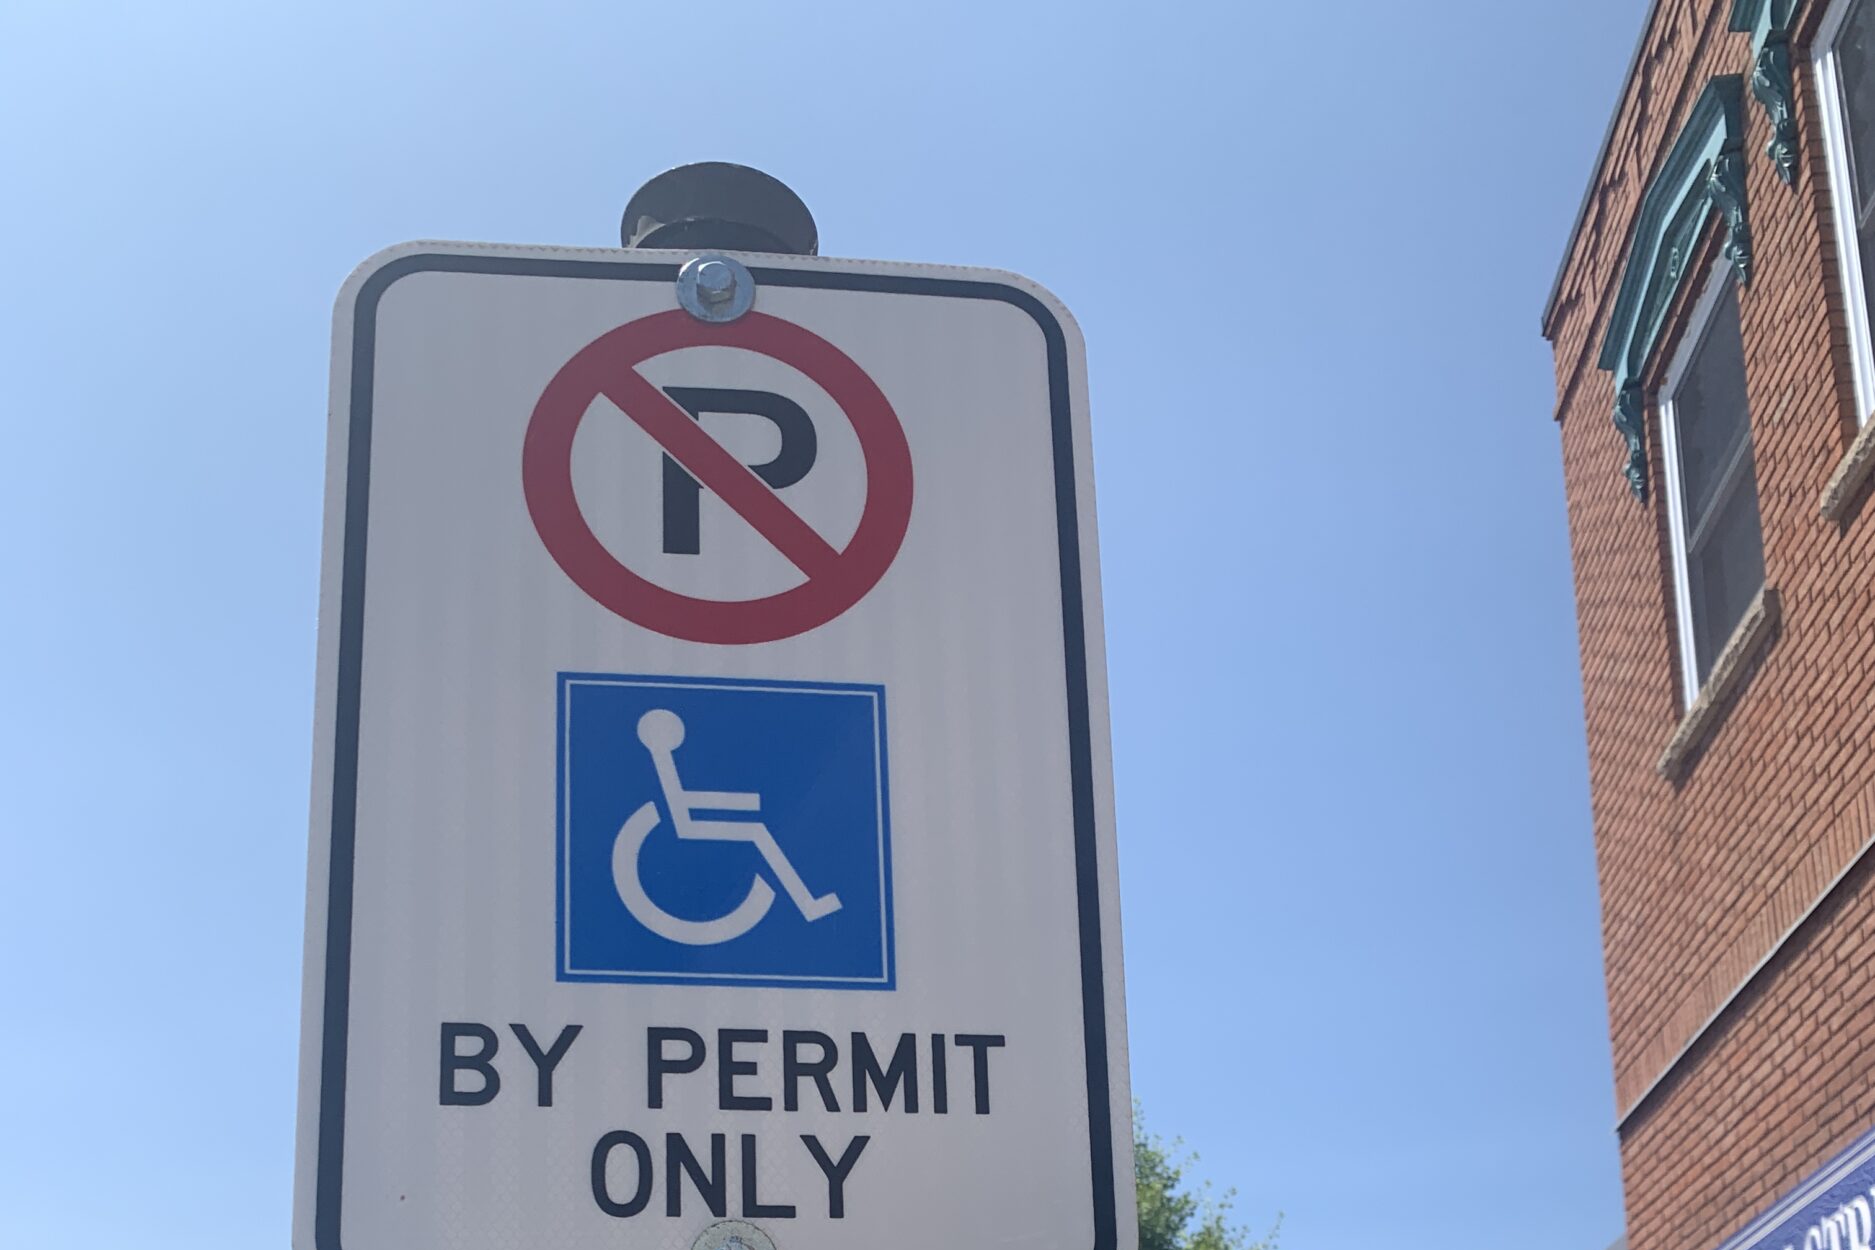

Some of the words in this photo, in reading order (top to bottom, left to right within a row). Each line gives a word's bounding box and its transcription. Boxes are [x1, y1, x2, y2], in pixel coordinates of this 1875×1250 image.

[662, 386, 818, 555] P
[439, 1022, 583, 1107] BY
[647, 1027, 1006, 1115] PERMIT
[591, 1130, 871, 1219] ONLY
